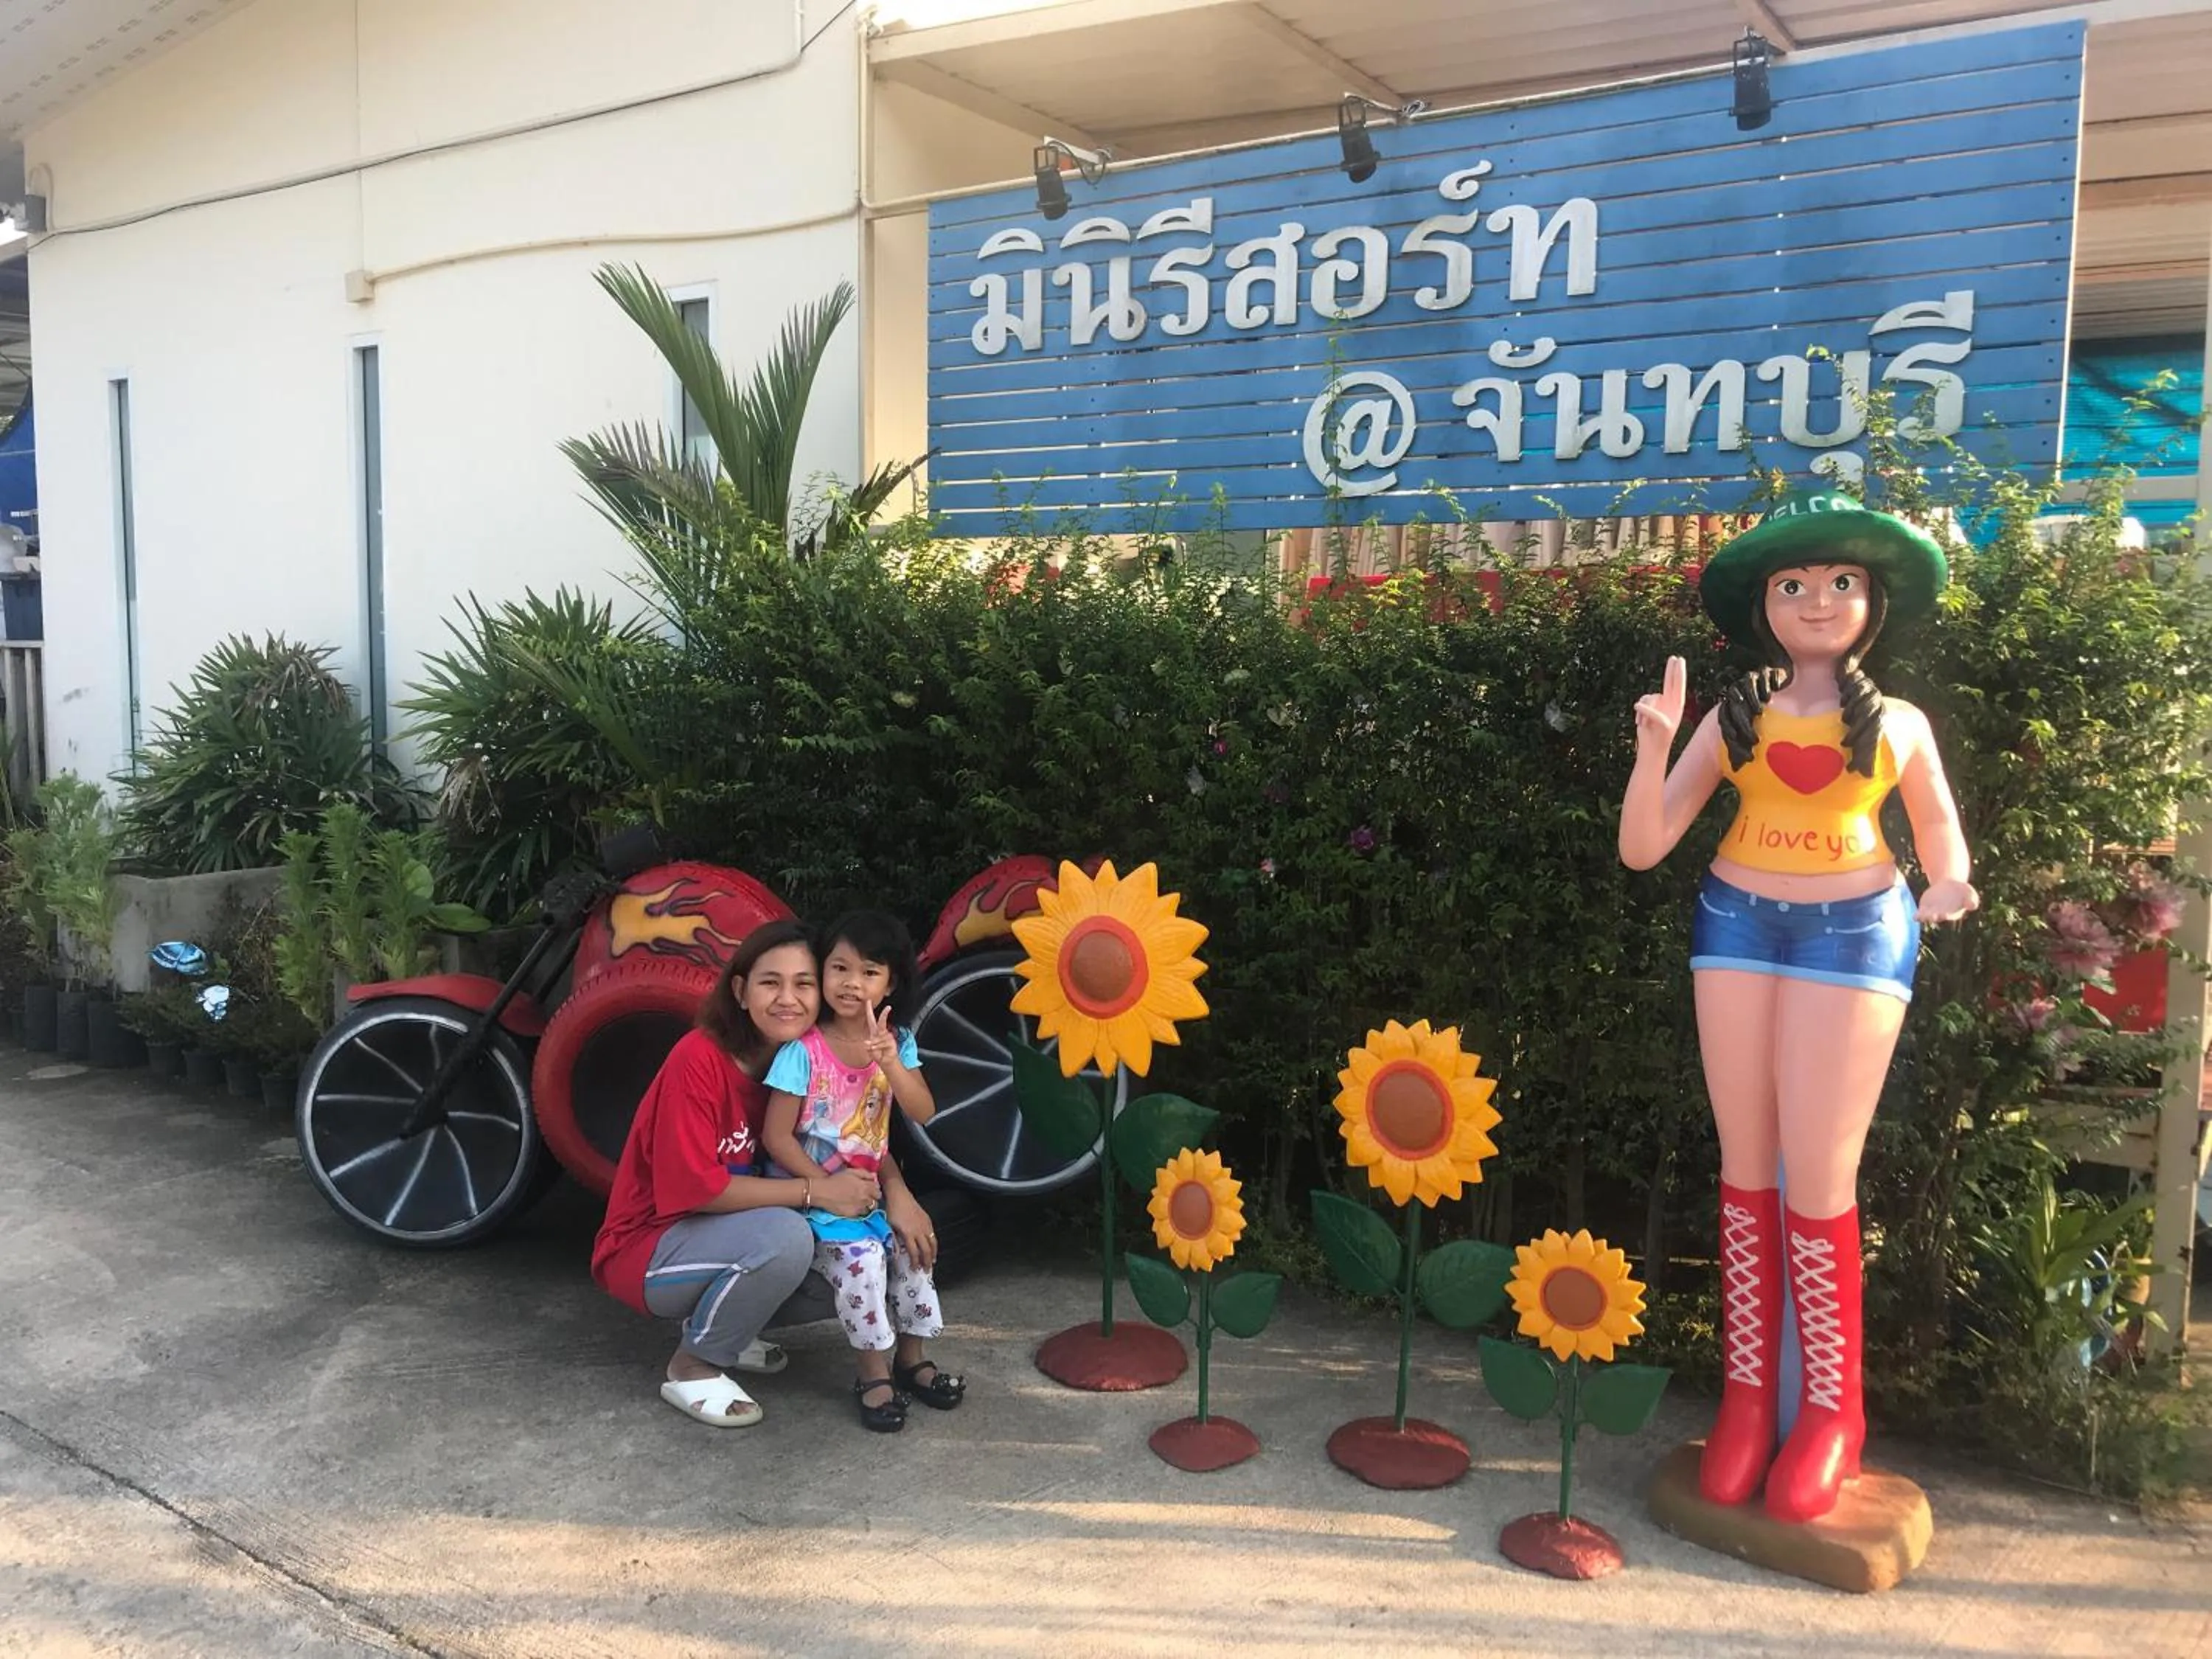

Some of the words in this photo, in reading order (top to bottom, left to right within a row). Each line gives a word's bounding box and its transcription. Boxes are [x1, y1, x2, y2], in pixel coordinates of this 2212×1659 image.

[969, 159, 1599, 355] มินิรีสอร์ท
[1451, 289, 1975, 493] จันทบุรี
[1757, 822, 1818, 852] love
